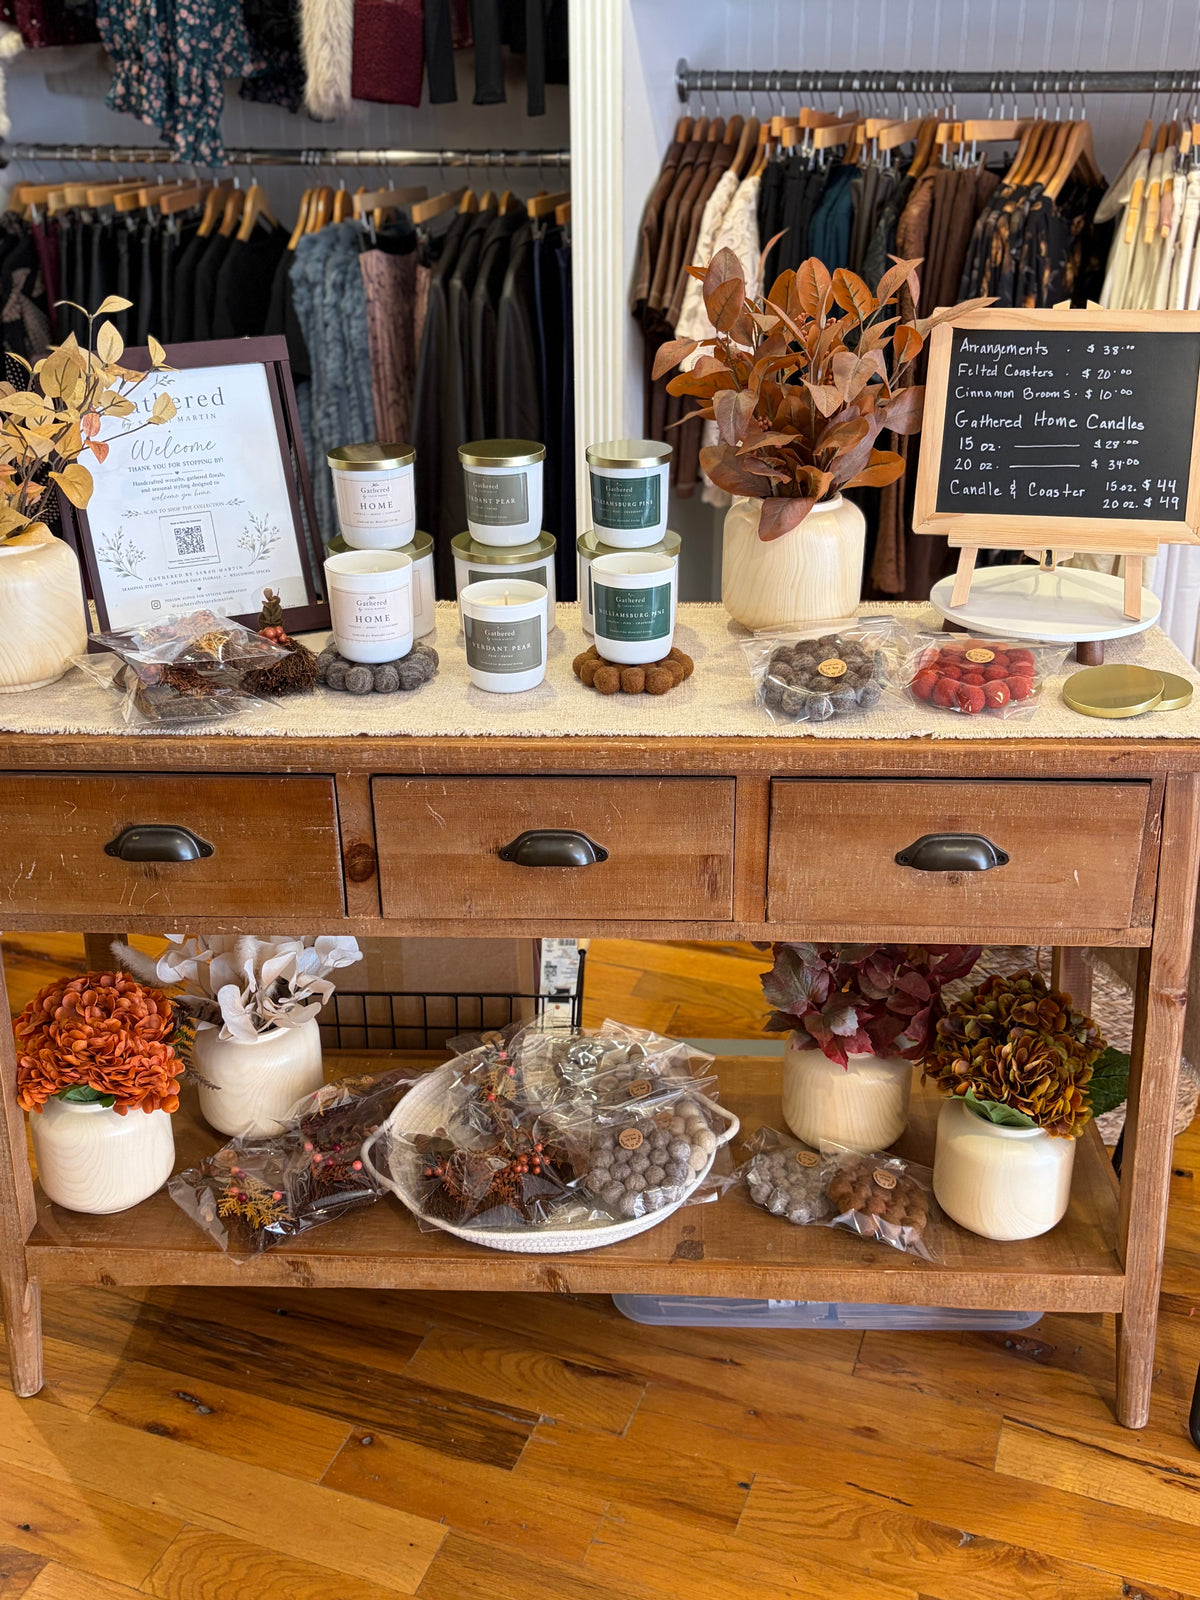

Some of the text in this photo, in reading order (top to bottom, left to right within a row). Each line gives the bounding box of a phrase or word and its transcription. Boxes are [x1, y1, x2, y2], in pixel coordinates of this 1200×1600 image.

[959, 336, 1049, 362] Arrangements
[957, 363, 998, 377] Felted
[1004, 364, 1054, 378] Coasters
[955, 386, 1015, 399] Cinnamon
[177, 412, 217, 423] MARTIN
[954, 409, 1145, 431] Gathered Home Candles
[131, 435, 217, 462] Welcome
[959, 436, 974, 451] 15
[980, 443, 1002, 452] oz.
[128, 465, 151, 473] THANK
[182, 459, 213, 467] STOPPING
[953, 458, 972, 471] 20
[979, 462, 999, 470] oz.
[360, 486, 391, 494] Gathered
[949, 479, 1003, 496] Candle
[1009, 479, 1017, 500] &
[1028, 481, 1086, 498] Coaster
[1157, 479, 1178, 493] 44
[360, 501, 394, 510] HOME
[1102, 498, 1119, 509] 20
[1159, 496, 1180, 510] 49
[356, 599, 388, 607] Gathered
[615, 596, 646, 604] Gathered
[355, 614, 391, 623] HOME
[484, 629, 516, 637] Gathered
[471, 641, 532, 652] VERDANT PEAR
